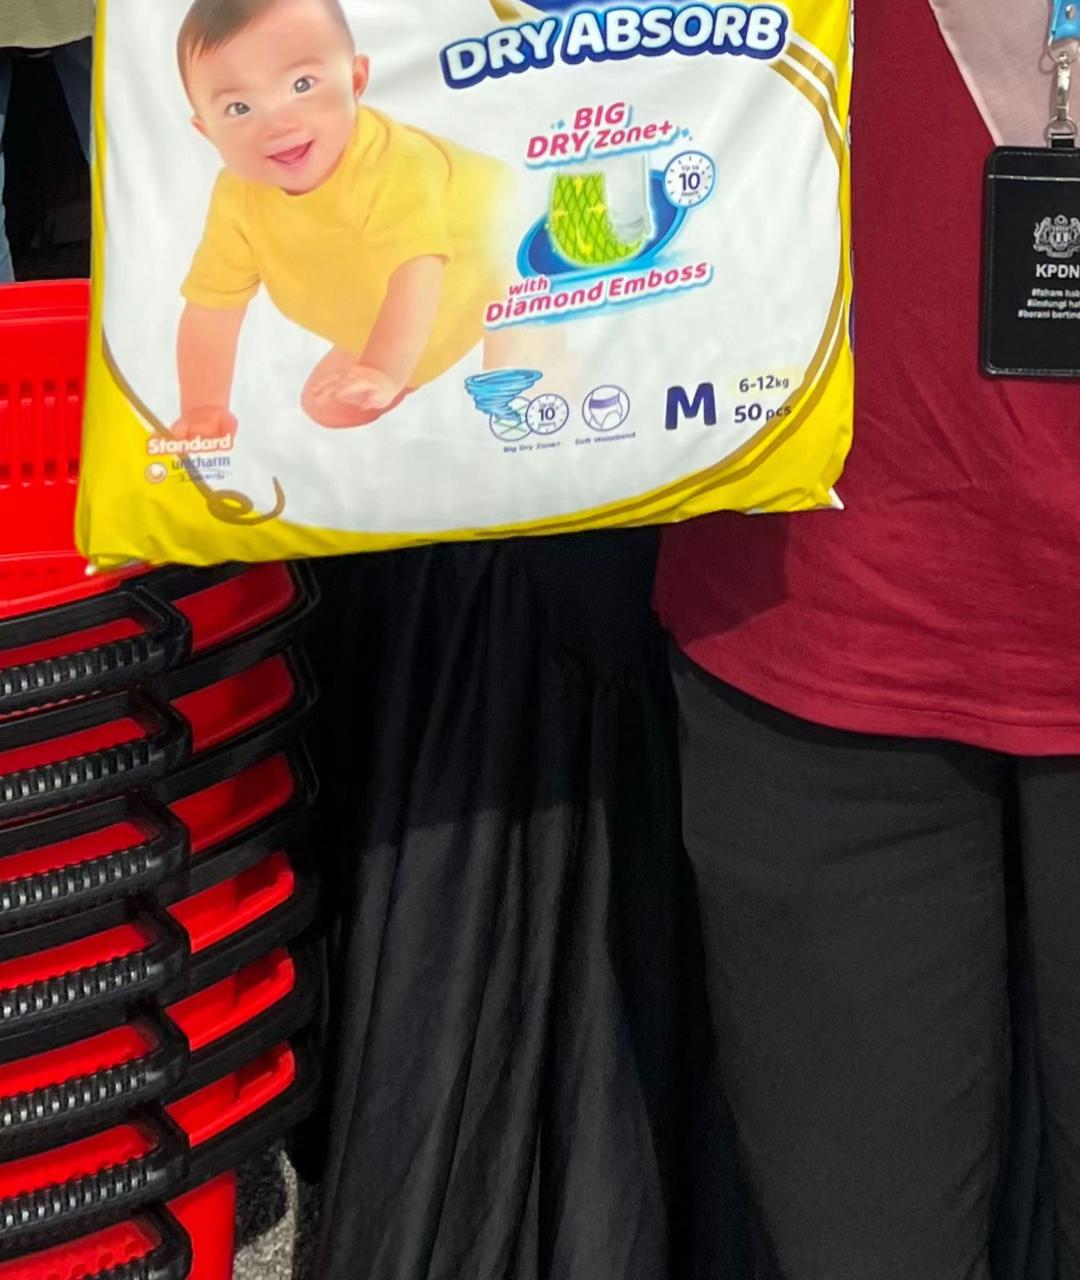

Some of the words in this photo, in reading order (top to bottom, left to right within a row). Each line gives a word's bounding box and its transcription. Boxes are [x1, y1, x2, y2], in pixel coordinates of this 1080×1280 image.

[444, 20, 559, 82] DRY
[566, 5, 783, 56] ABSORB
[573, 101, 626, 130] BIG
[526, 130, 590, 160] DRY
[593, 119, 674, 150] Zone+
[679, 172, 701, 191] 10
[1035, 264, 1080, 279] KPDN
[485, 281, 603, 323] Diamond
[608, 261, 708, 298] Emboss
[508, 277, 549, 296] with
[738, 374, 790, 394] 6-12kg
[538, 406, 556, 422] 10
[664, 382, 718, 431] M
[733, 402, 763, 424] 50
[764, 405, 793, 423] pcs
[147, 434, 233, 456] Standard
